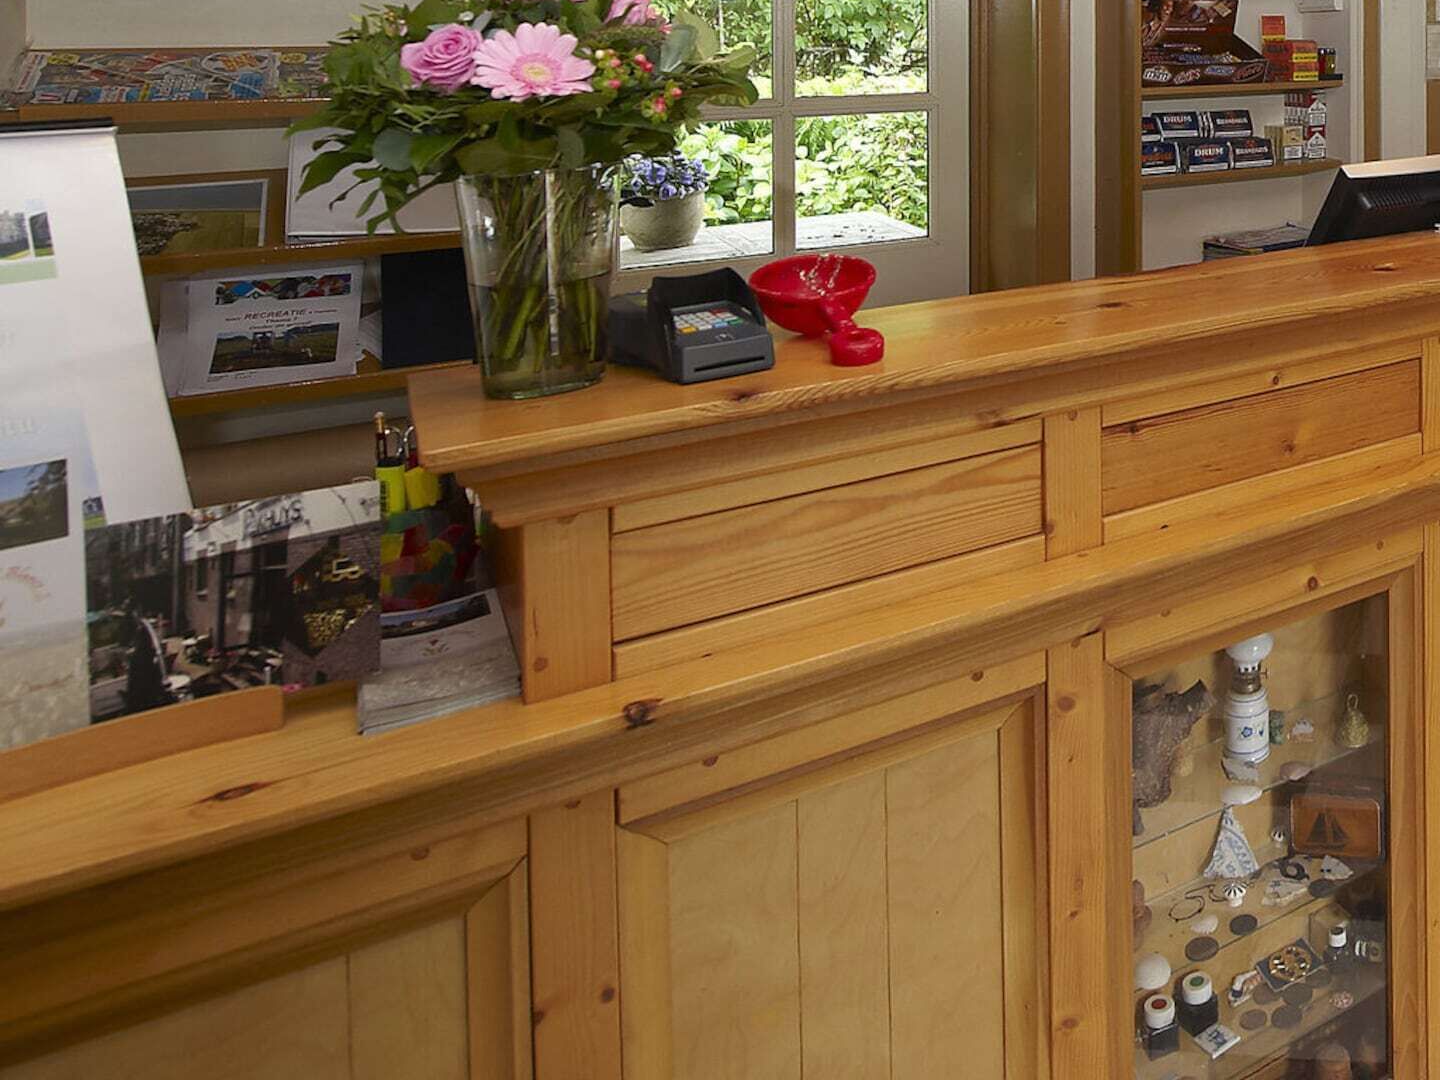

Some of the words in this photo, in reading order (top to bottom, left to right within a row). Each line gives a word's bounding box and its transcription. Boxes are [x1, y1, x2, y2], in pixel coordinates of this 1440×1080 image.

[1163, 115, 1192, 124] DRUM
[1194, 147, 1224, 157] DRUM
[244, 309, 305, 320] RECREATIE
